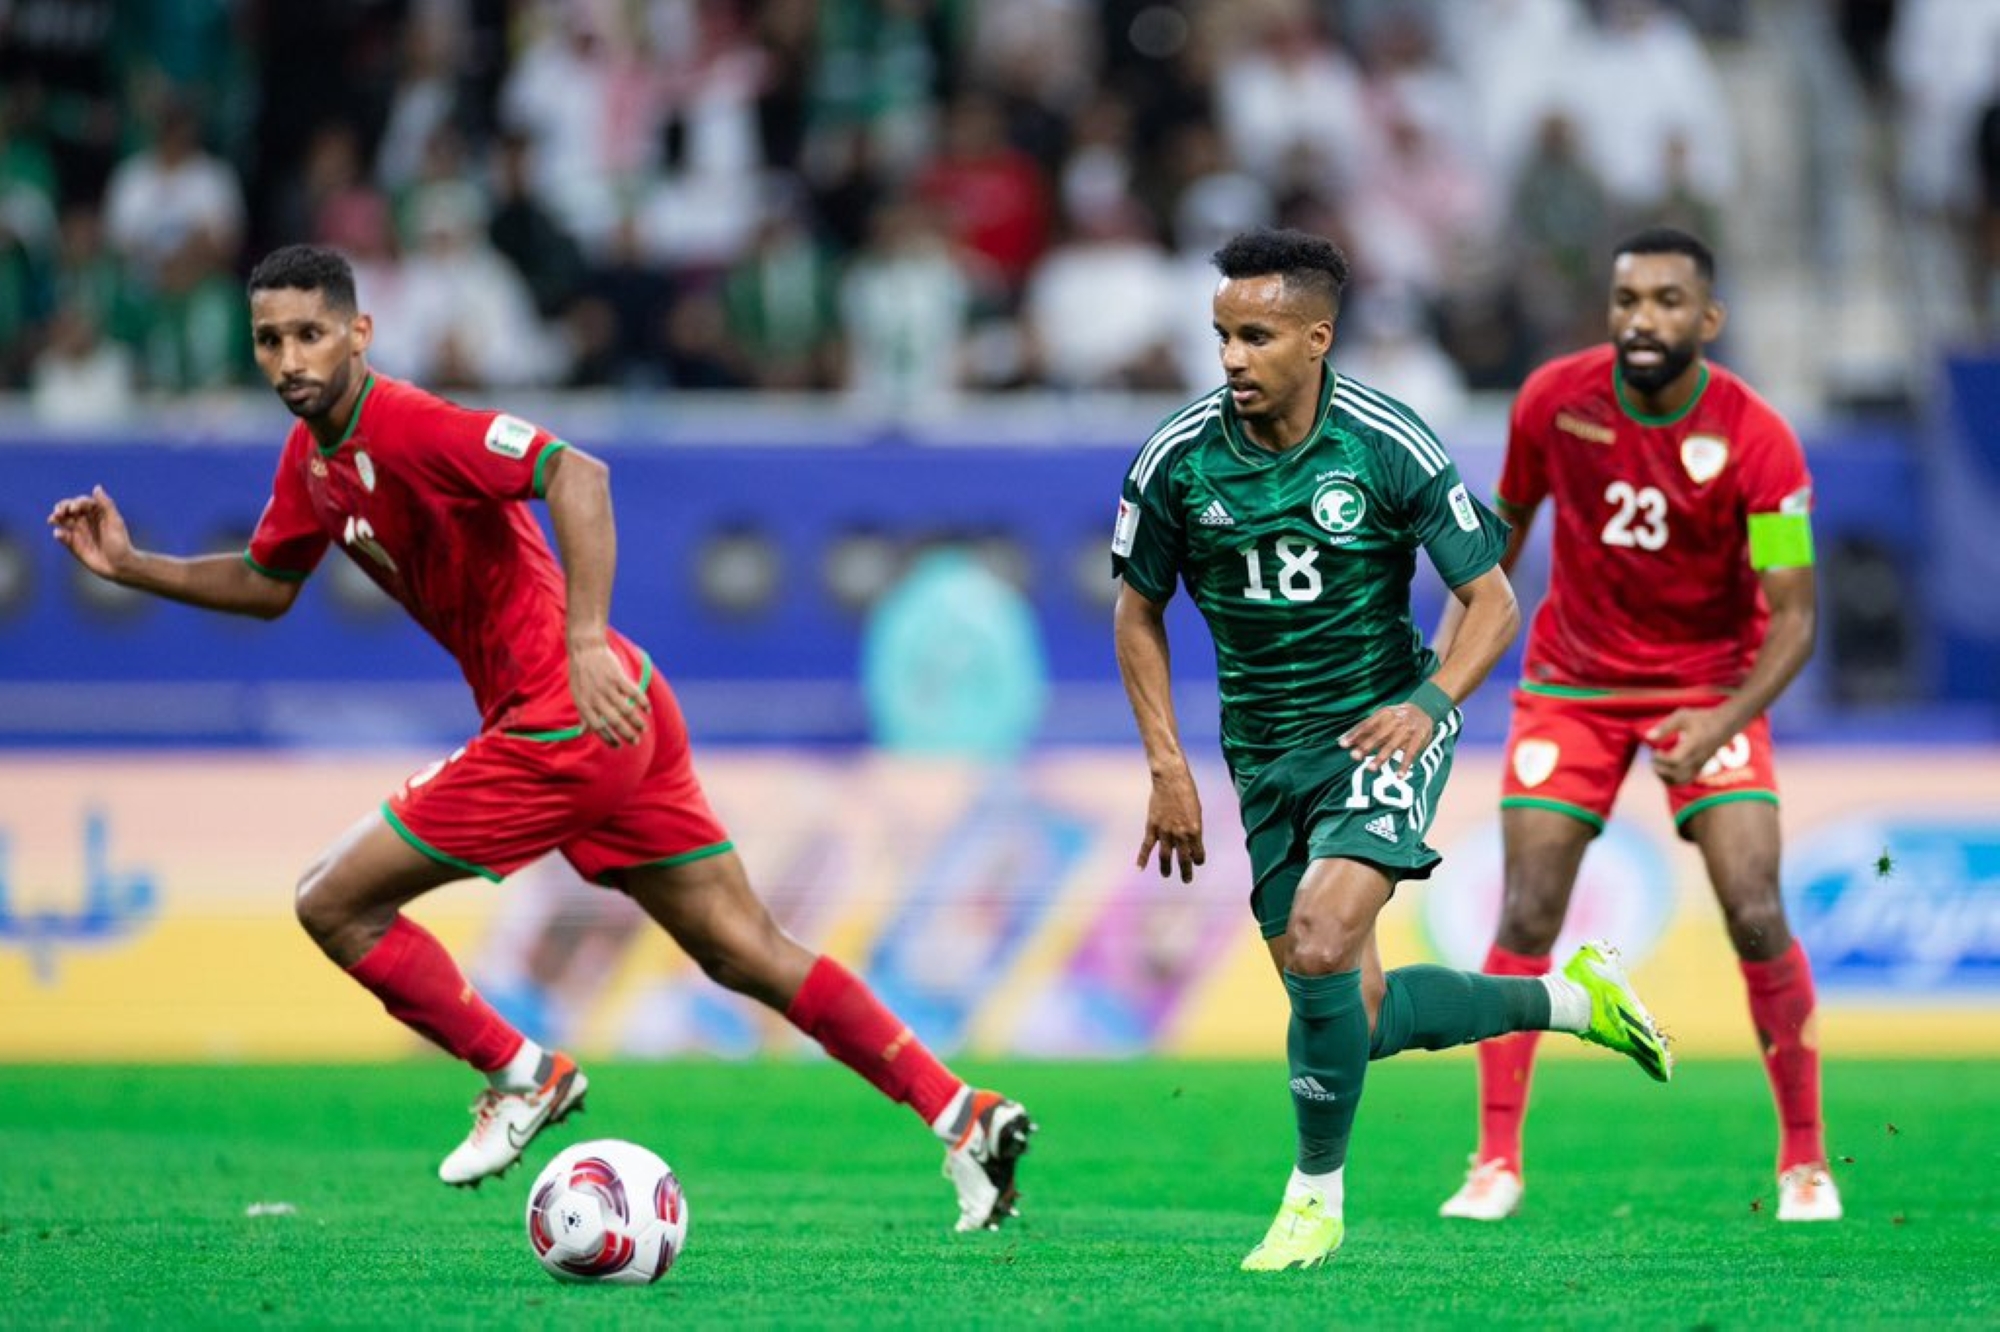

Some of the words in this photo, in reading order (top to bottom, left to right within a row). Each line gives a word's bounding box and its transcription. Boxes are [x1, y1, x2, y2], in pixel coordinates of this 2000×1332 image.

[1199, 517, 1235, 526] adidas
[1601, 481, 1669, 551] 23
[1237, 536, 1323, 602] 18
[1345, 749, 1415, 810] 18
